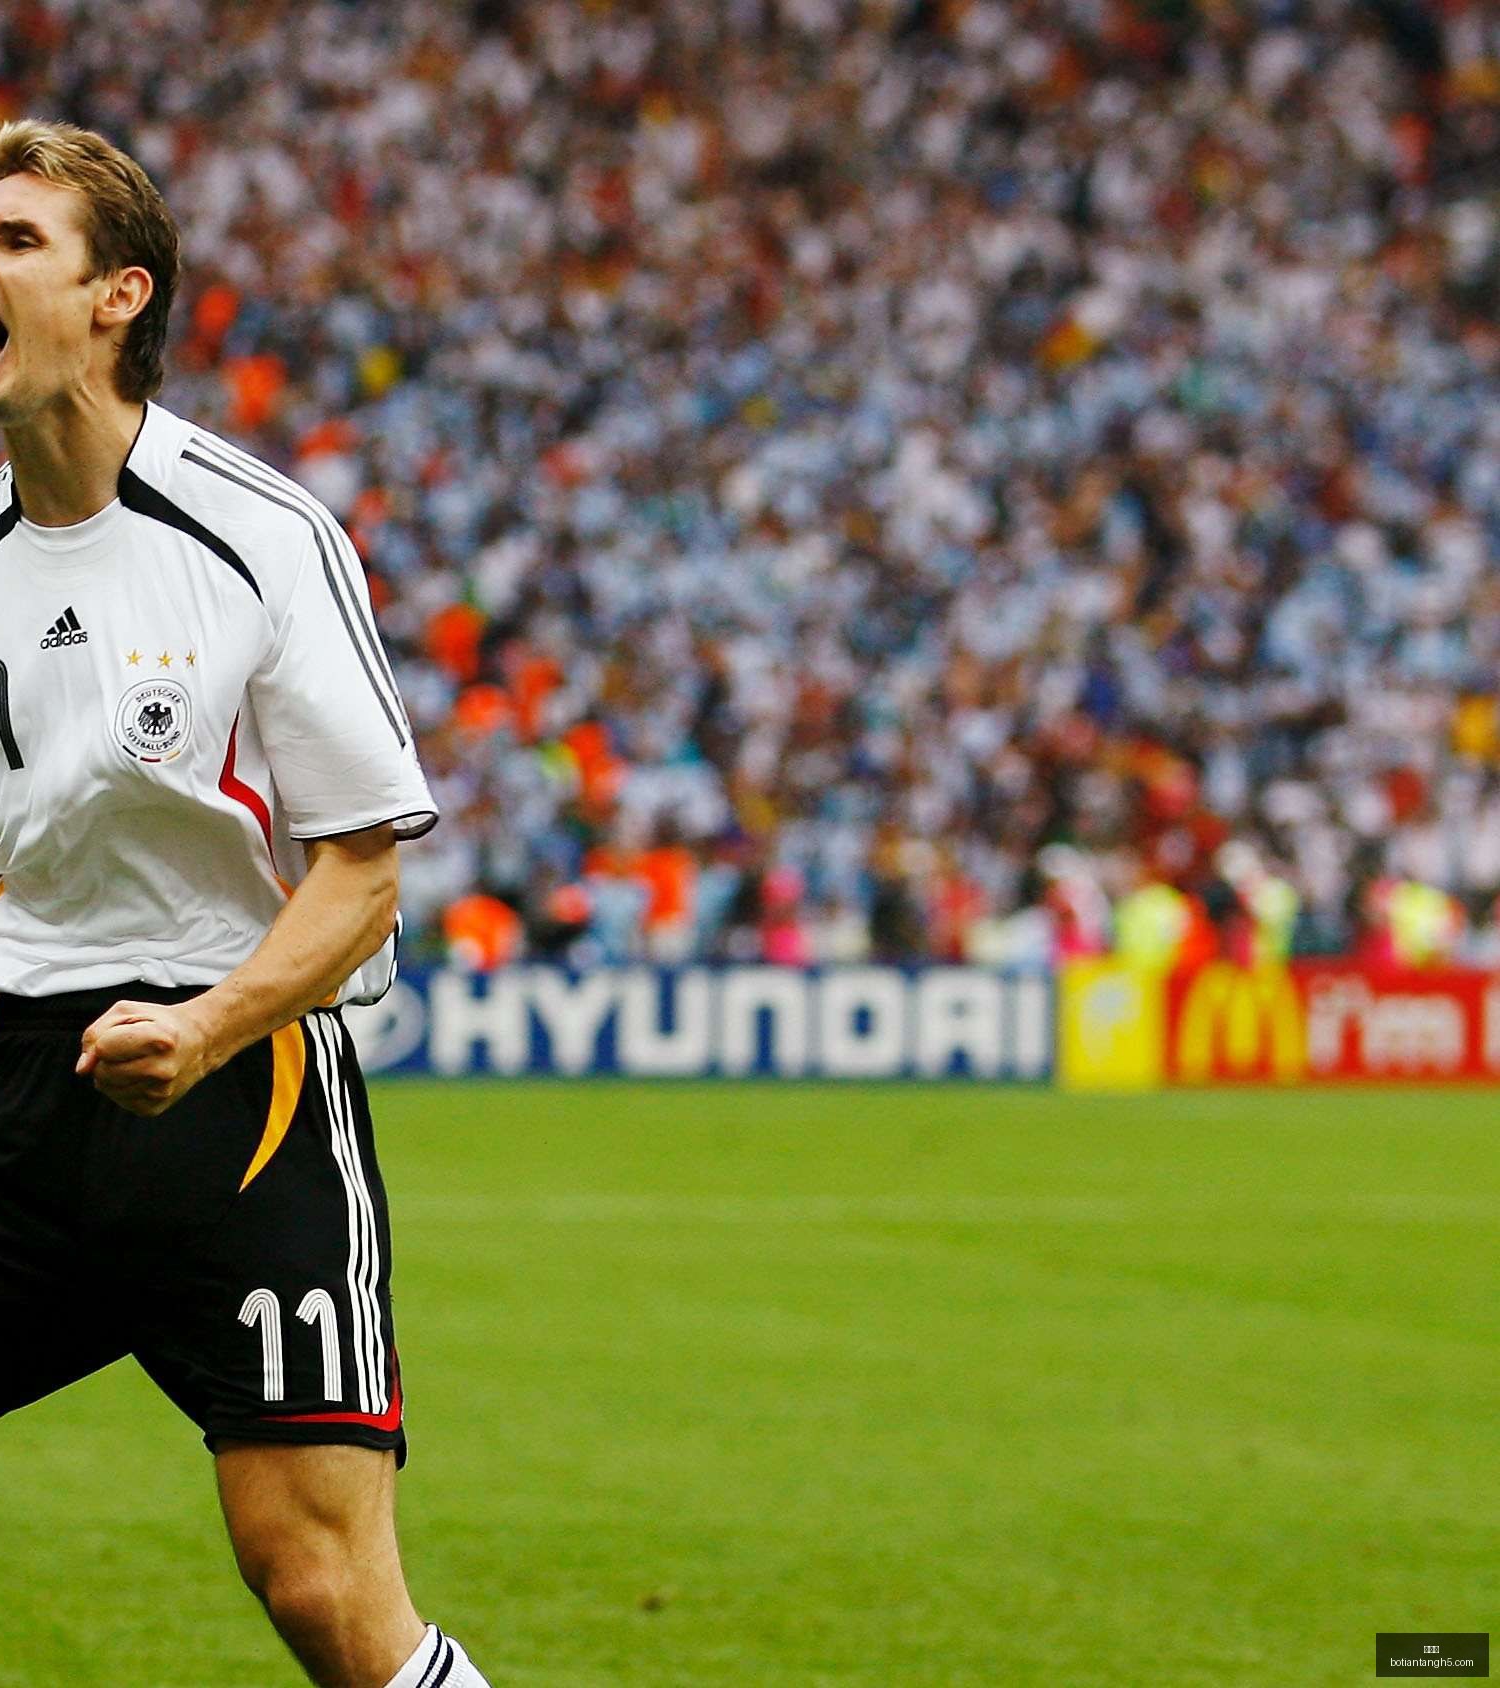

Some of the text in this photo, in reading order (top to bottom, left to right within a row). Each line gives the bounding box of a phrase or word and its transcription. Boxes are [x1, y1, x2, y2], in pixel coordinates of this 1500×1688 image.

[40, 631, 88, 650] adidas
[428, 967, 1051, 1077] HYUNDAI
[237, 1287, 343, 1402] 11
